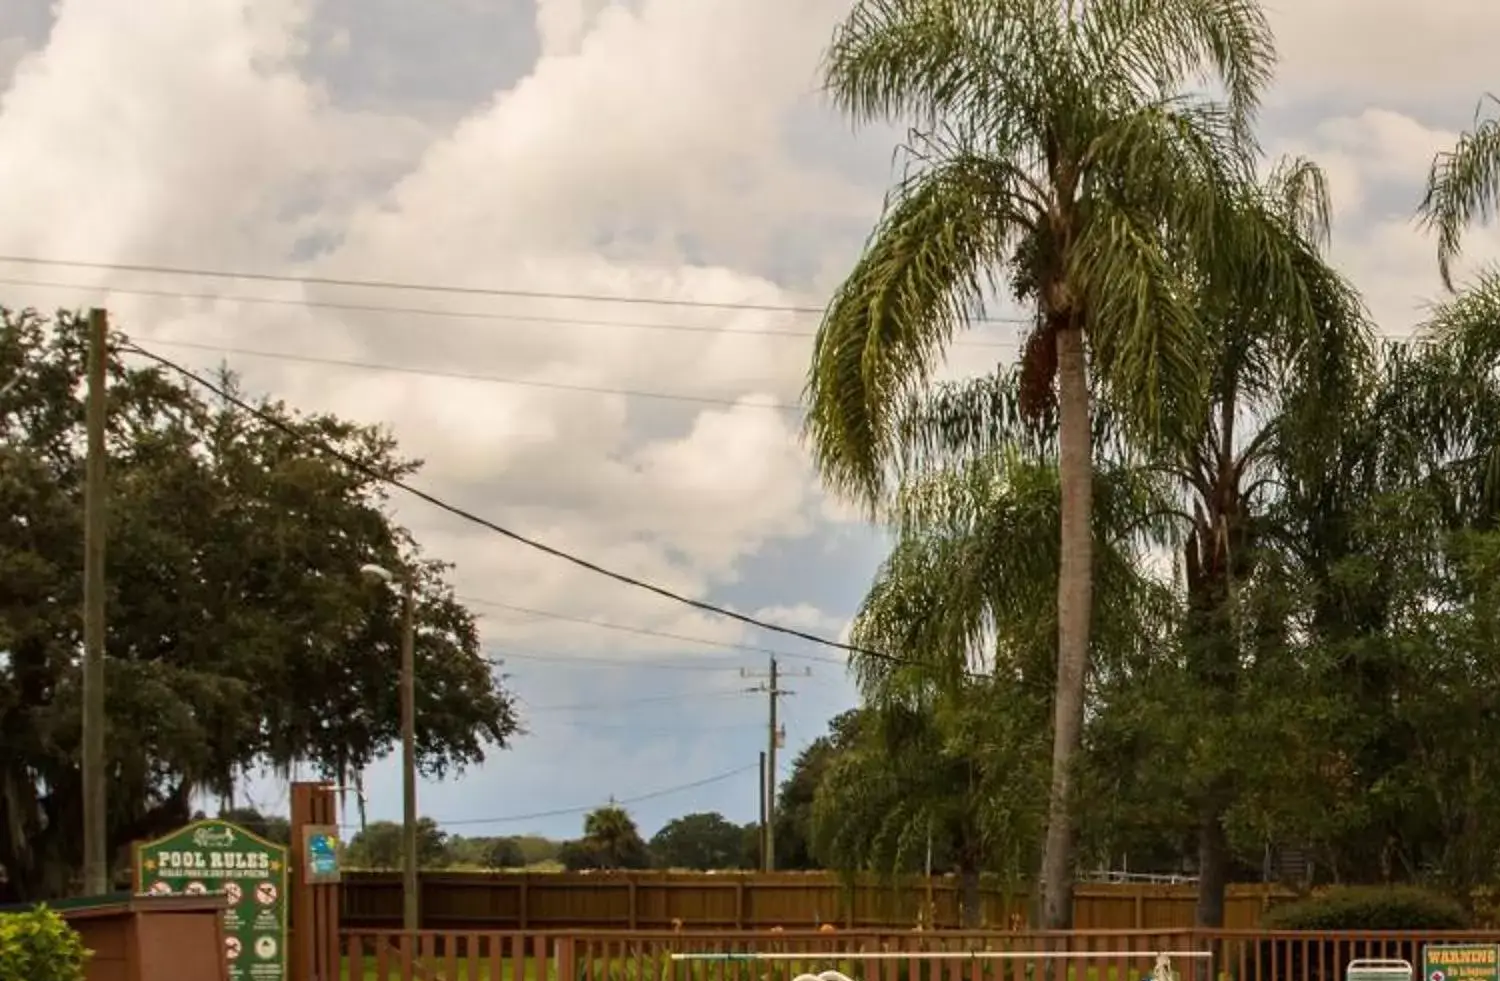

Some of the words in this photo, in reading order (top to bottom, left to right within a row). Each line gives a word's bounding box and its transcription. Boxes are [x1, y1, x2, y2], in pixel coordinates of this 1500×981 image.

[158, 851, 206, 868] POOL
[210, 851, 269, 869] RULES
[1427, 949, 1496, 964] WARNING
